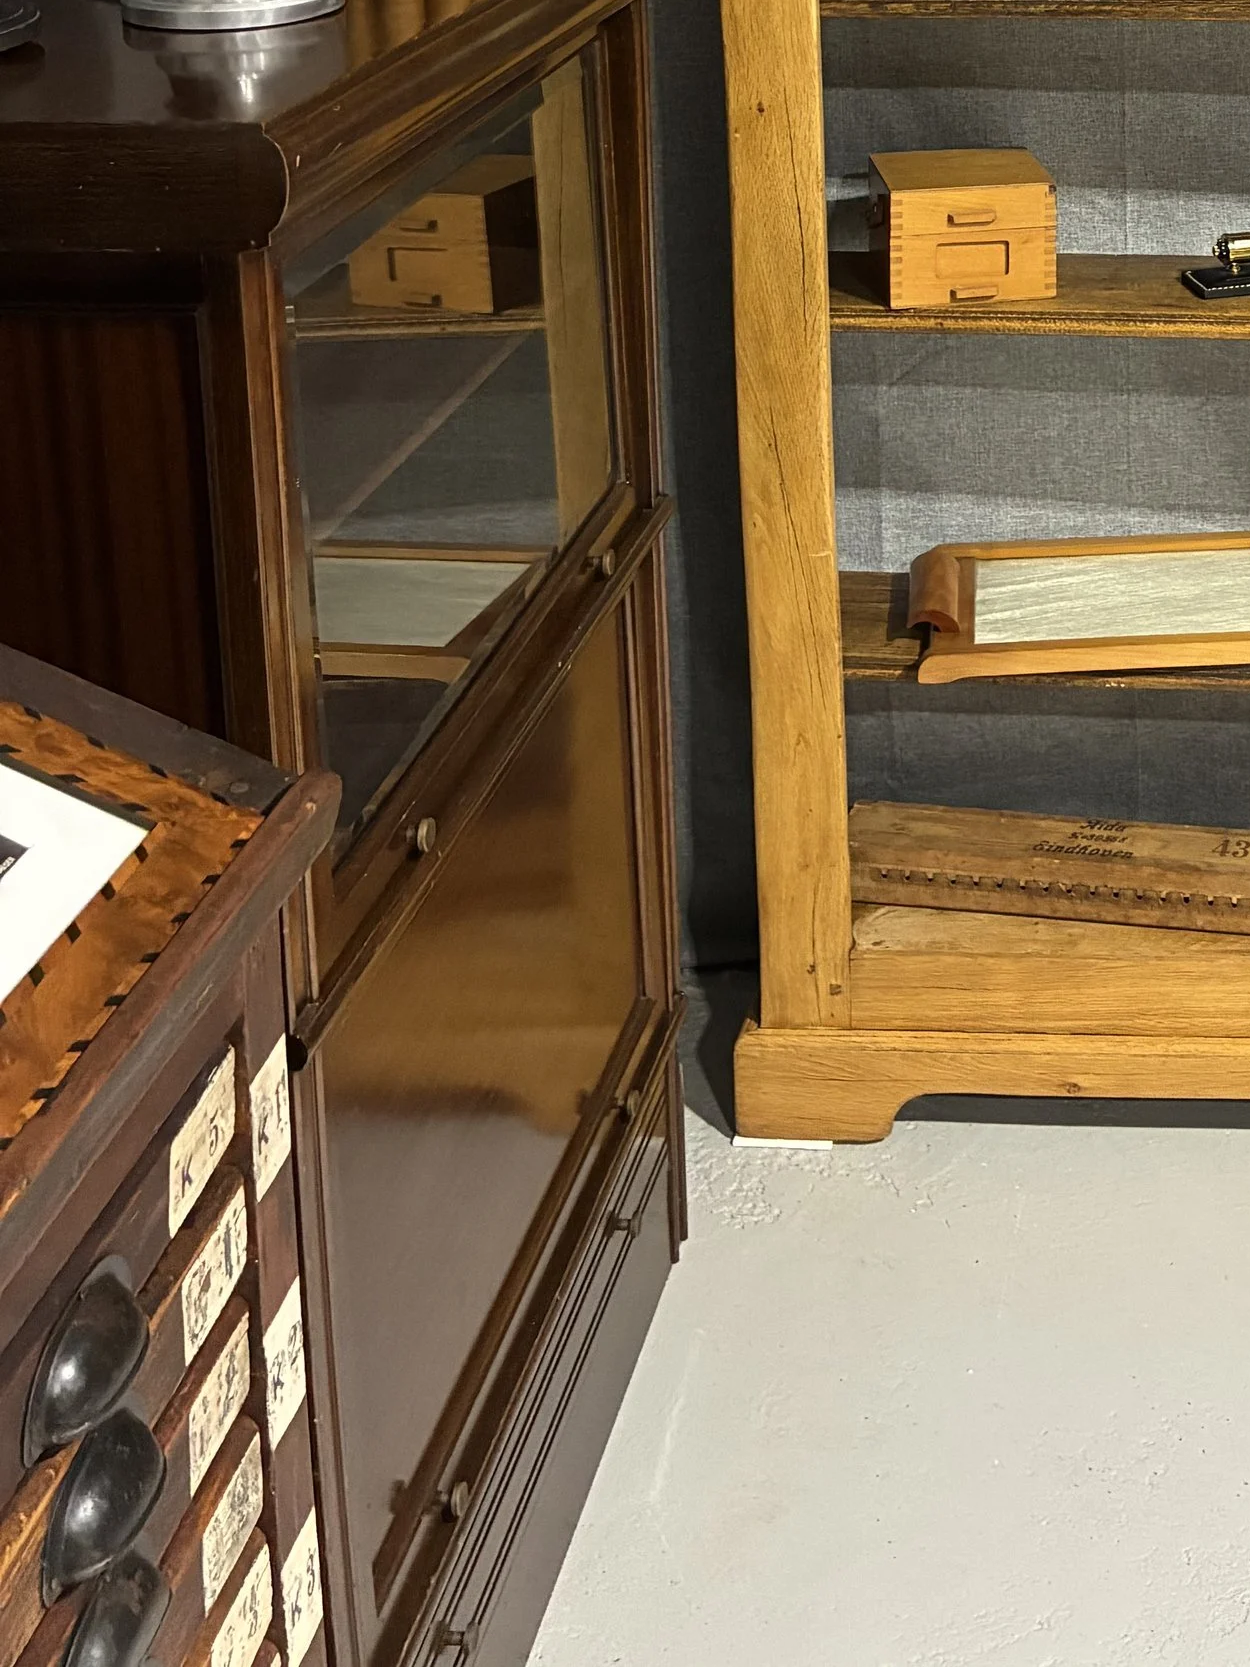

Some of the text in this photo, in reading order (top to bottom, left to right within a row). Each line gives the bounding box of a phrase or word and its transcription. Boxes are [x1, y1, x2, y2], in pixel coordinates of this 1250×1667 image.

[1032, 840, 1134, 858] Eindhoven
[1211, 838, 1250, 859] 43
[181, 1108, 219, 1198] K 5
[306, 1551, 316, 1597] 3
